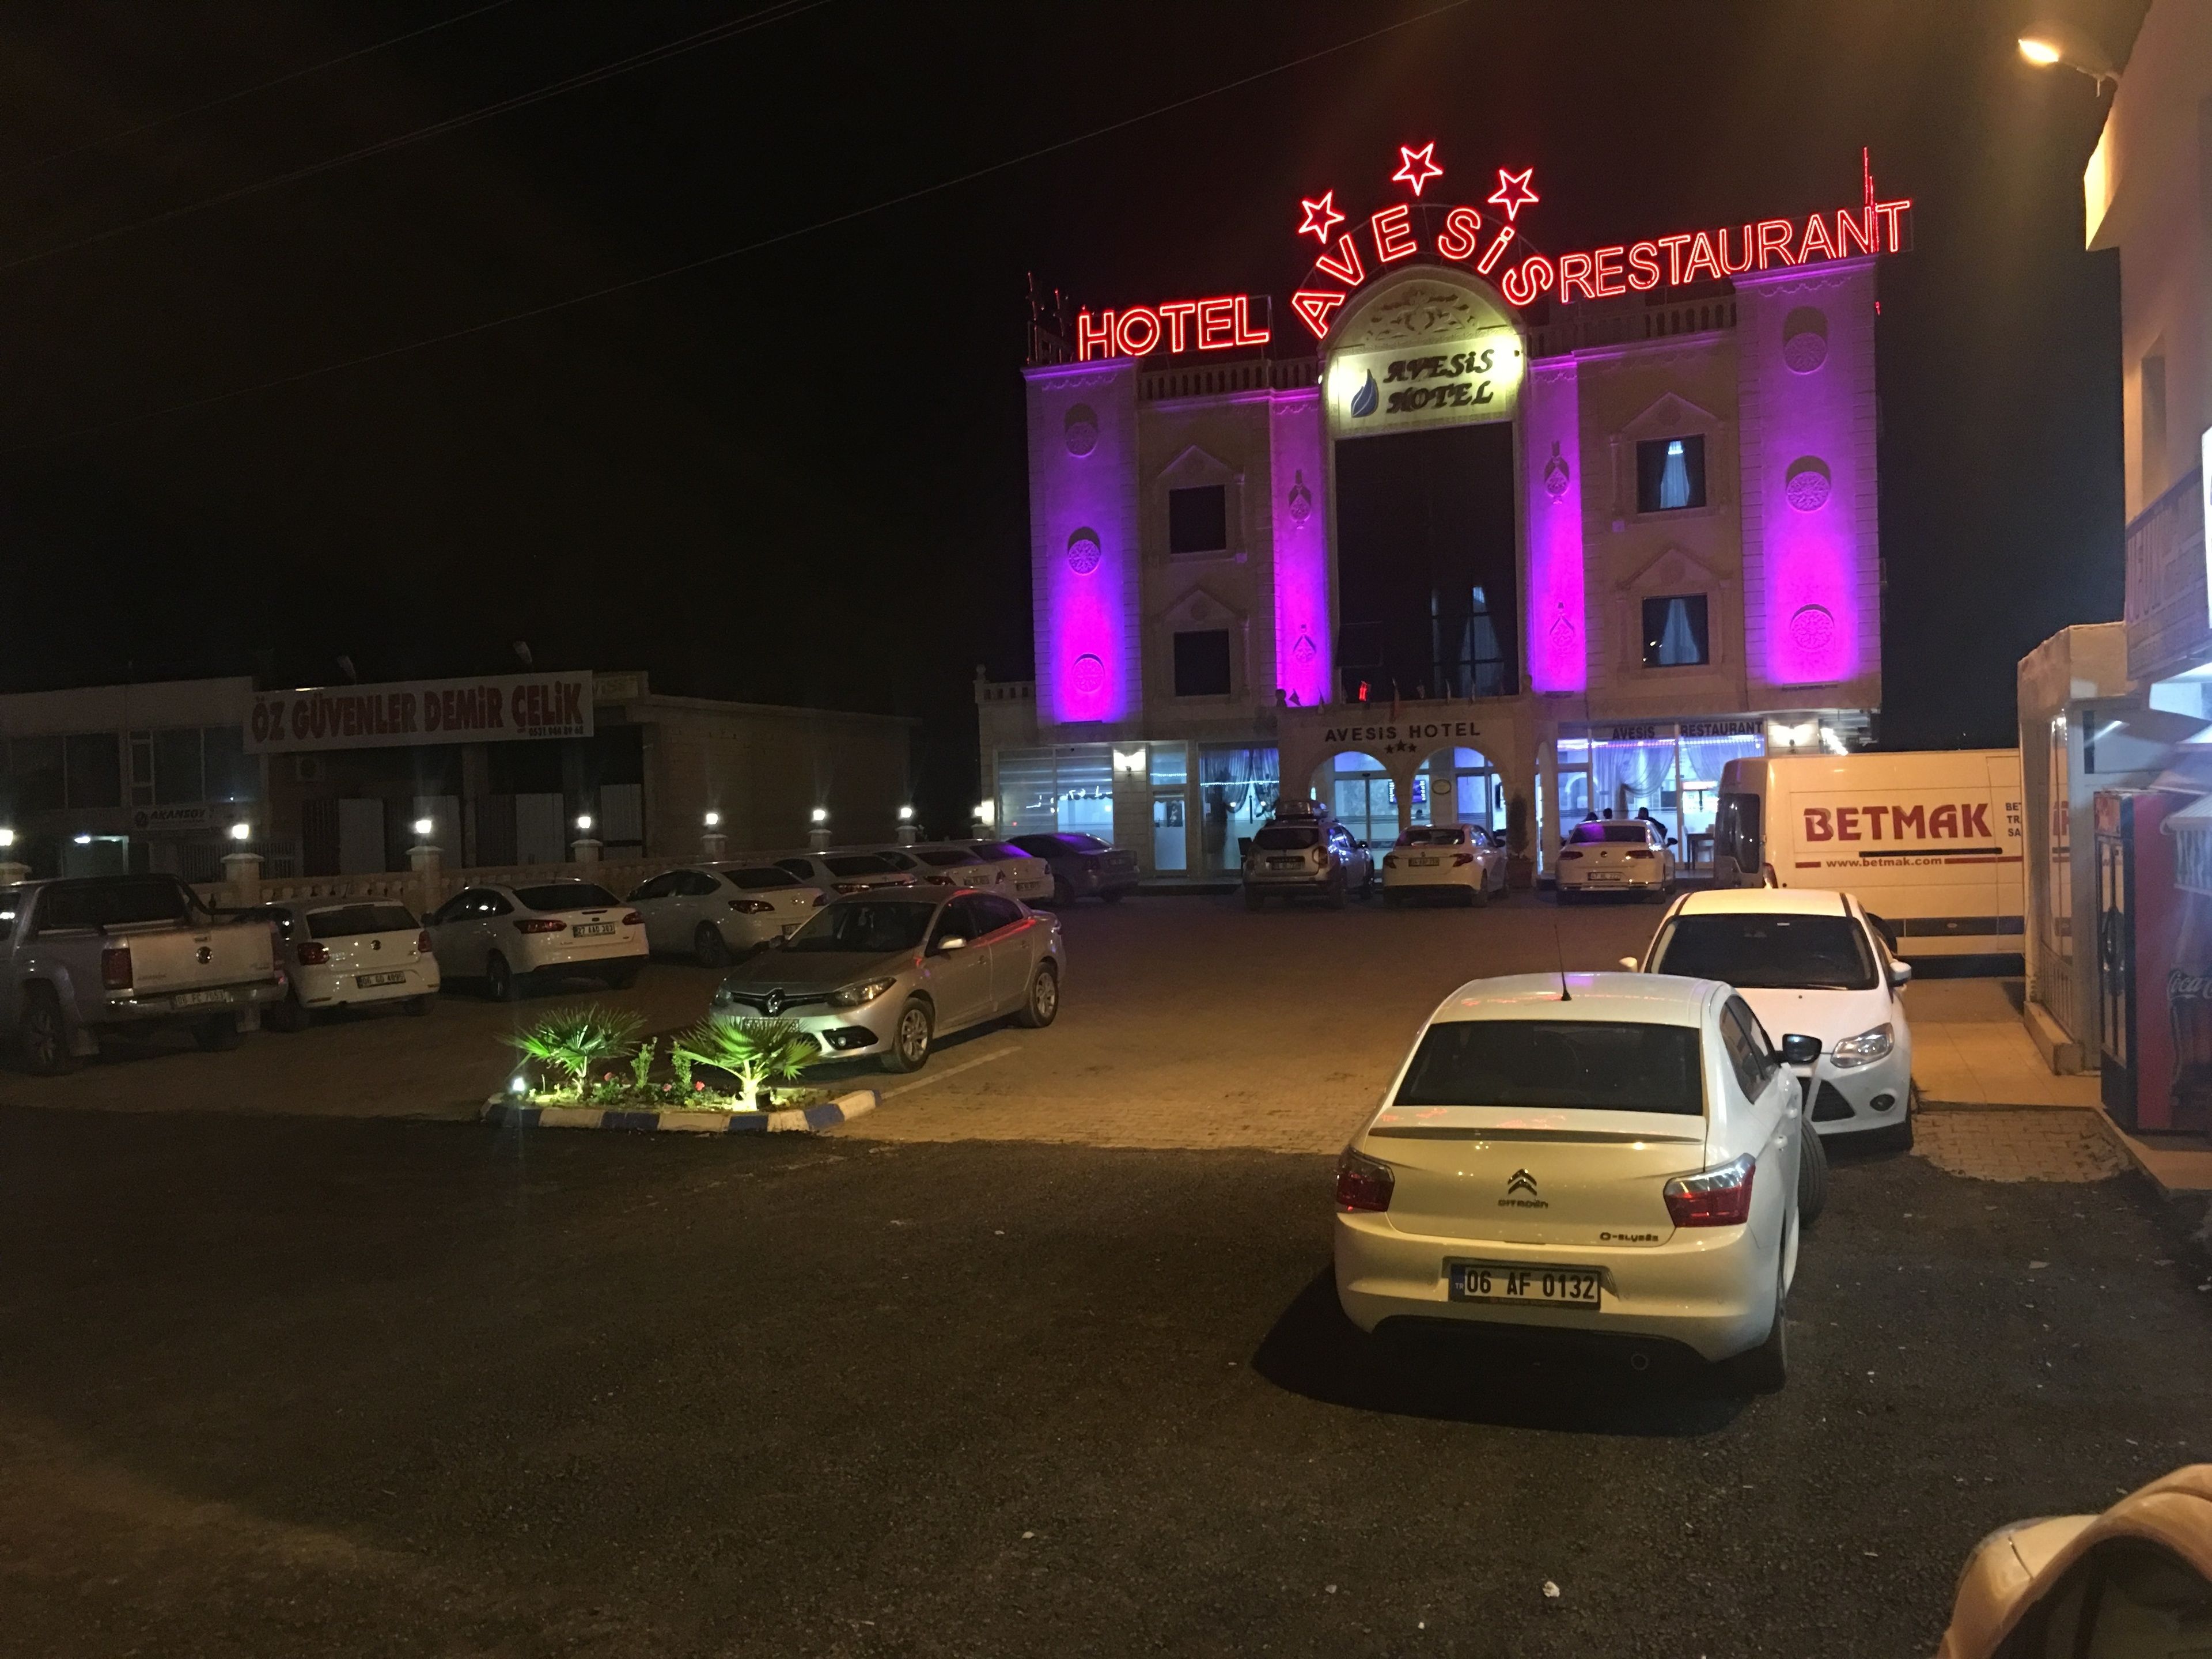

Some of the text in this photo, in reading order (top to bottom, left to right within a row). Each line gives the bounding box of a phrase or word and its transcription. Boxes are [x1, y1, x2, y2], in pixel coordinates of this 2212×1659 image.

[1559, 200, 1912, 304] RESTAURANT
[1078, 294, 1270, 361] HOTEL
[1386, 380, 1494, 414] HOTEL
[251, 695, 286, 743] ÖZ
[291, 692, 418, 740] GÜVENLER
[1409, 722, 1481, 739] HOTEL
[1680, 721, 1763, 737] RESTAURANT
[1804, 803, 1993, 842] BETMAK
[1826, 856, 1942, 868] www.betmak.com
[1455, 1270, 1594, 1300] TR 06 AF 0132
